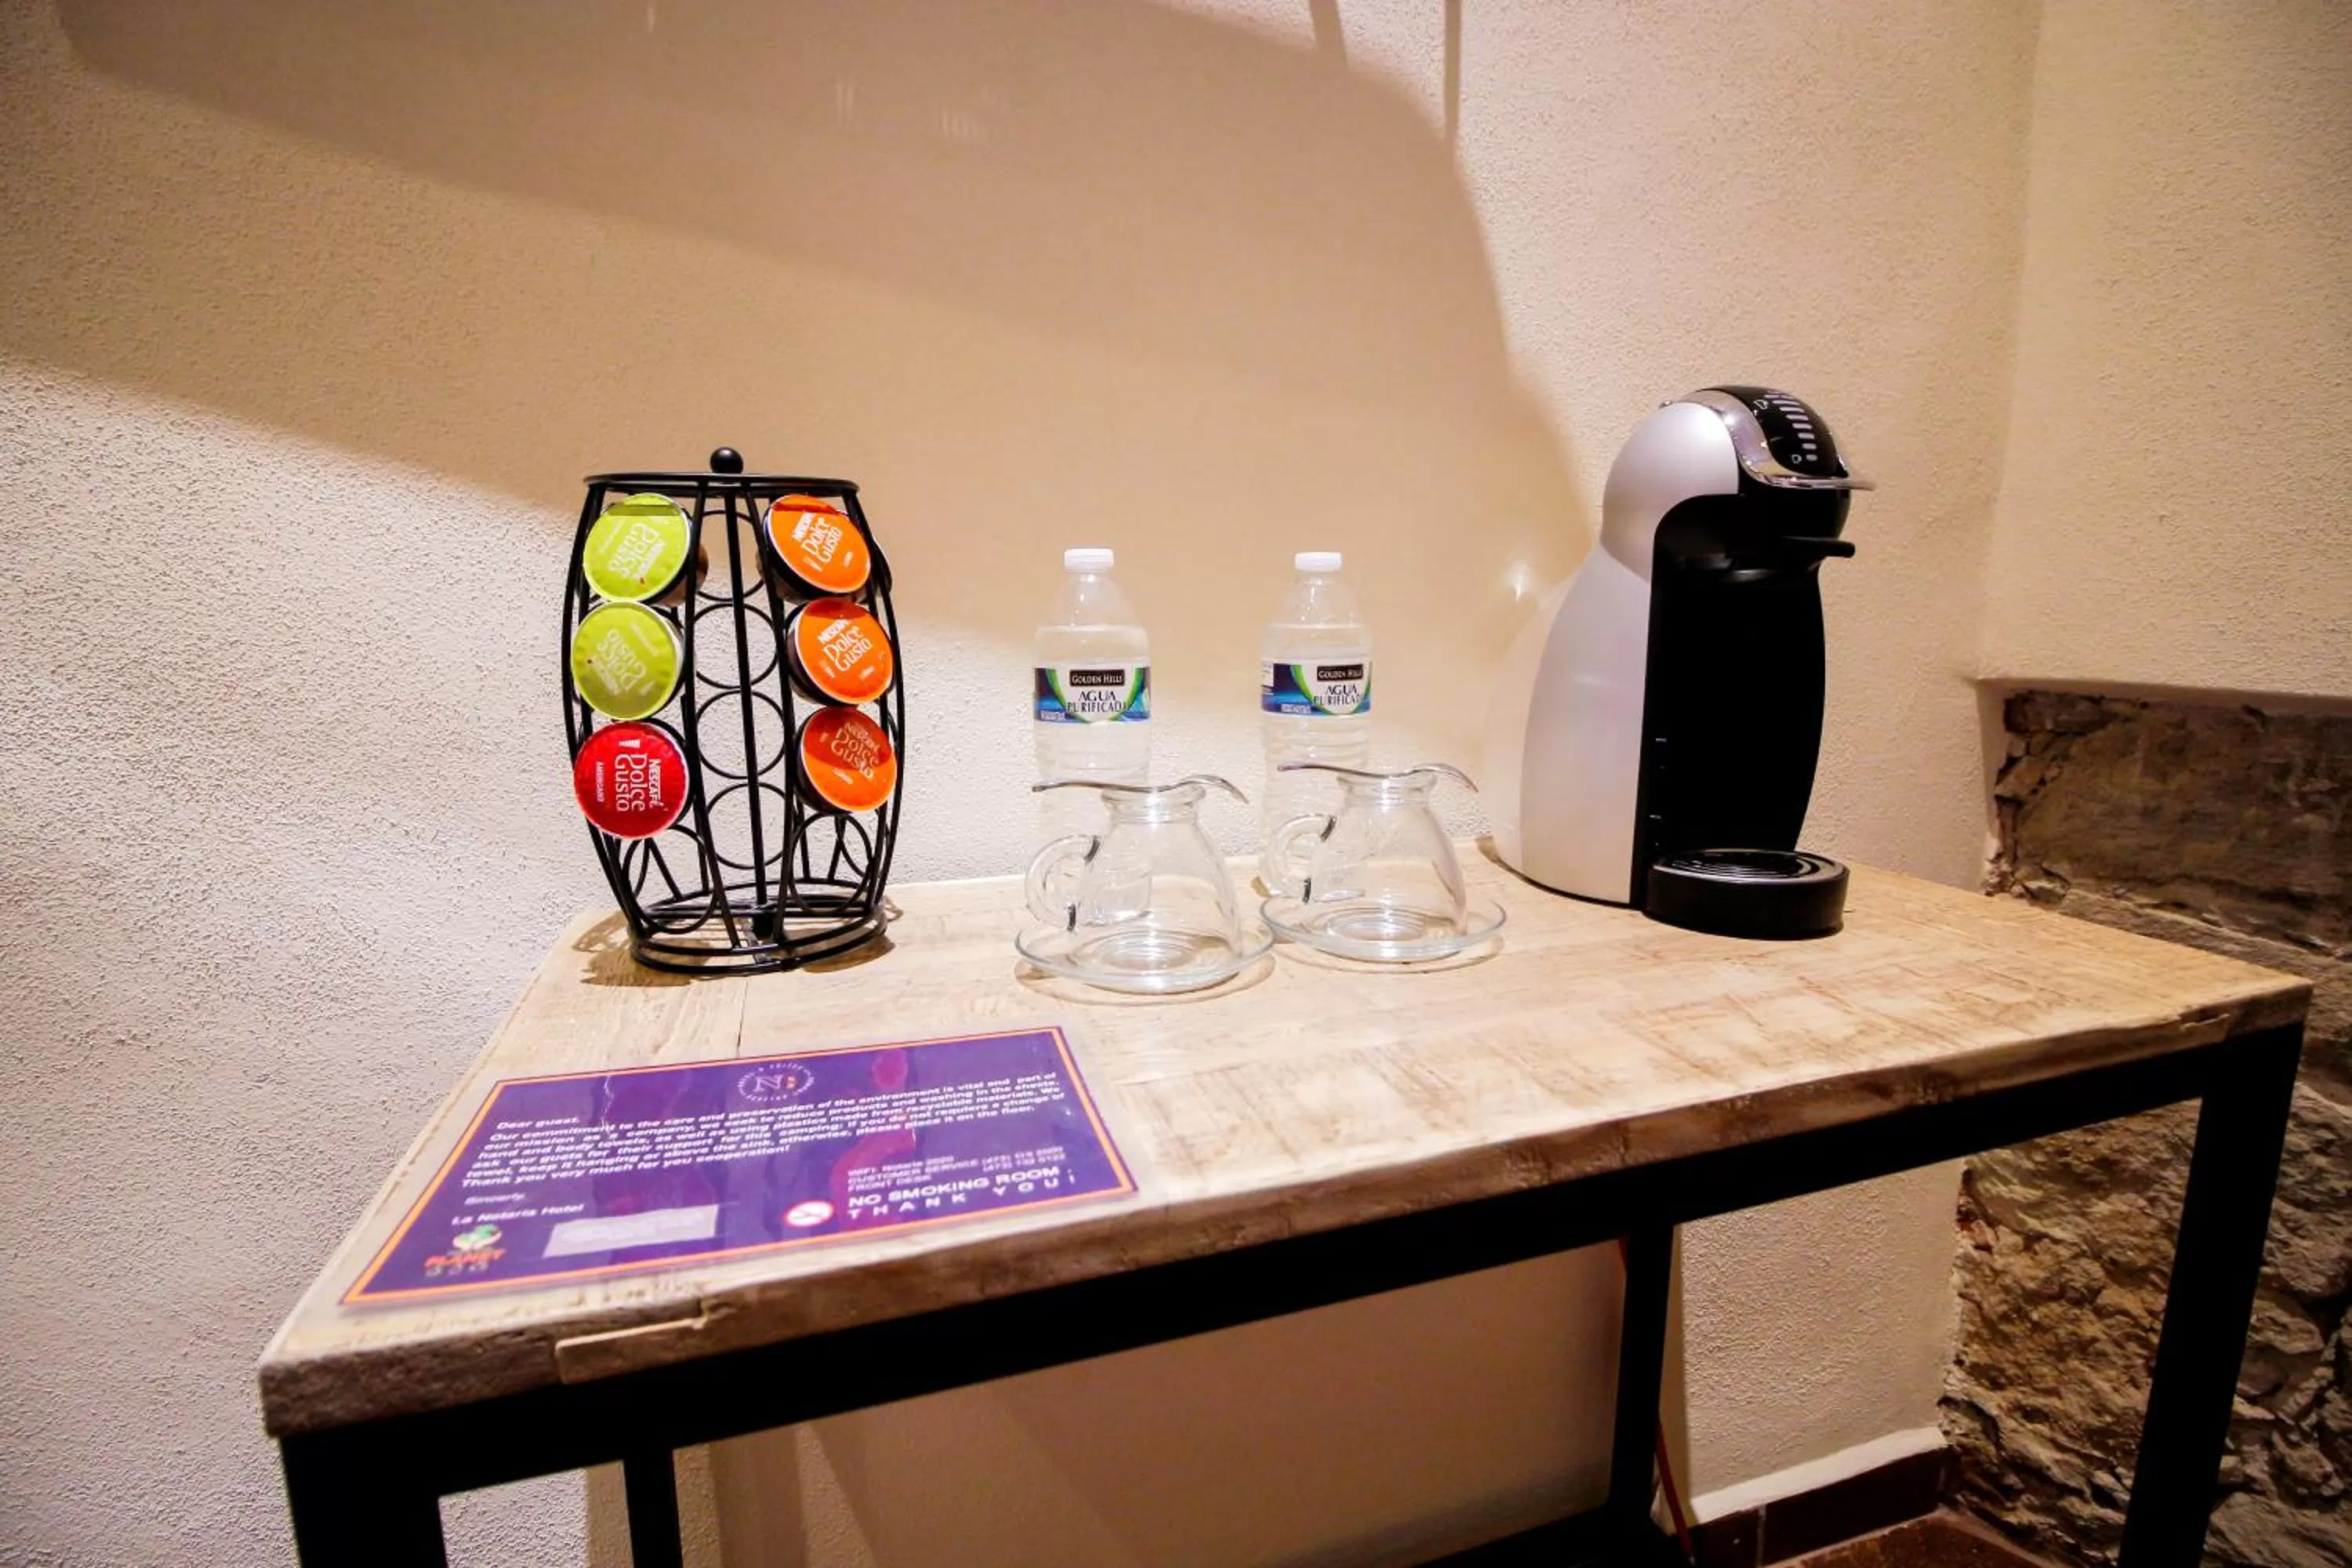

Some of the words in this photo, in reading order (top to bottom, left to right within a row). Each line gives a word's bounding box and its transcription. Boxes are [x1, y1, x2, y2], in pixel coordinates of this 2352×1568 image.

[800, 517, 831, 556] Dolce
[817, 526, 844, 563] Gusto
[822, 626, 863, 661] Dolce
[835, 637, 873, 672] Gusto
[1072, 675, 1102, 684] GOLDEN
[1103, 674, 1123, 684] HILLS
[1078, 690, 1116, 702] AGUA
[1326, 684, 1358, 696] AGUA
[831, 740, 875, 779] Gusto
[836, 728, 880, 767] Dolce
[615, 753, 630, 812] Gusto
[630, 753, 648, 812] Dolce
[514, 1137, 574, 1146] mission
[724, 1117, 756, 1126] seek
[778, 1110, 824, 1120] reduce
[829, 1102, 887, 1115] products
[891, 1098, 916, 1106] and
[920, 1091, 972, 1102] washing
[522, 1124, 614, 1138] commitment
[699, 1112, 724, 1121] and
[728, 1105, 813, 1119] preservation
[859, 1087, 939, 1103] environment
[987, 1078, 1010, 1087] and
[1017, 1075, 1040, 1083] part
[472, 1160, 499, 1168] ask
[617, 1145, 652, 1153] their
[656, 1138, 712, 1149] support
[860, 1118, 885, 1127] you
[478, 1149, 518, 1159] hand
[522, 1145, 552, 1154] and
[555, 1143, 593, 1152] body
[677, 1131, 705, 1139] well
[730, 1124, 768, 1134] using
[773, 1117, 826, 1129] plastics
[830, 1112, 867, 1121] made
[871, 1108, 902, 1116] from
[519, 1163, 557, 1172] keep
[575, 1155, 639, 1167] hanging
[663, 1147, 709, 1157] above
[856, 1123, 900, 1134] please
[904, 1118, 940, 1128] place
[463, 1176, 510, 1186] Thank
[515, 1174, 546, 1183] you
[551, 1169, 585, 1178] very
[589, 1163, 632, 1174] much
[663, 1157, 691, 1167] you
[848, 1193, 882, 1208] NO
[888, 1177, 989, 1202] SMOKING
[995, 1166, 1060, 1185] ROOM
